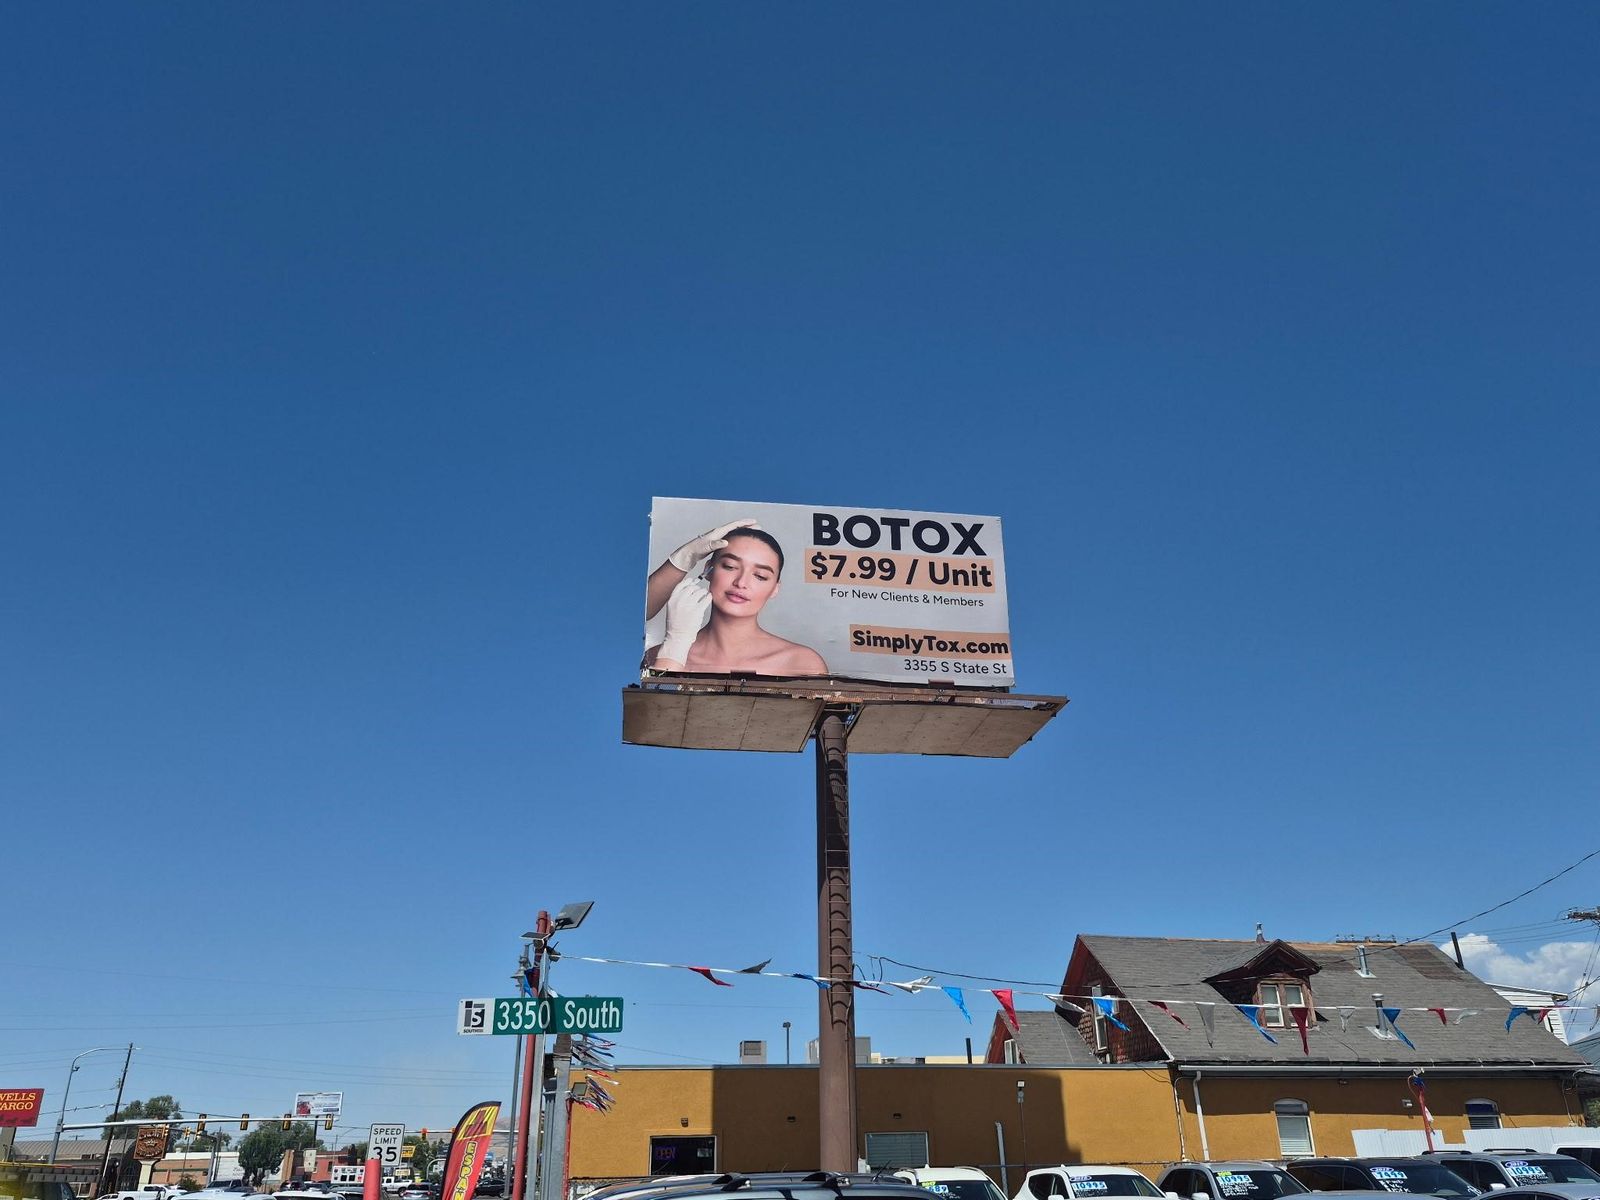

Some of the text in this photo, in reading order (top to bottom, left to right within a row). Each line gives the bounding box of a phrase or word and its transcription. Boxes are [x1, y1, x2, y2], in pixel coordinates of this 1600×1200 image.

[812, 512, 987, 556] BOTOX
[811, 551, 993, 587] $7.99 / Unit
[830, 588, 984, 607] For New Clients & Members
[852, 630, 1009, 654] SimplyTox.com
[904, 659, 1007, 674] 3355 S State St
[497, 1000, 620, 1030] 3350 South
[373, 1127, 402, 1135] SPEED
[375, 1137, 397, 1145] LIMIT
[373, 1146, 397, 1162] 35
[1511, 1166, 1543, 1175] 10995
[1075, 1181, 1106, 1190] 10995
[1220, 1175, 1250, 1183] 10995
